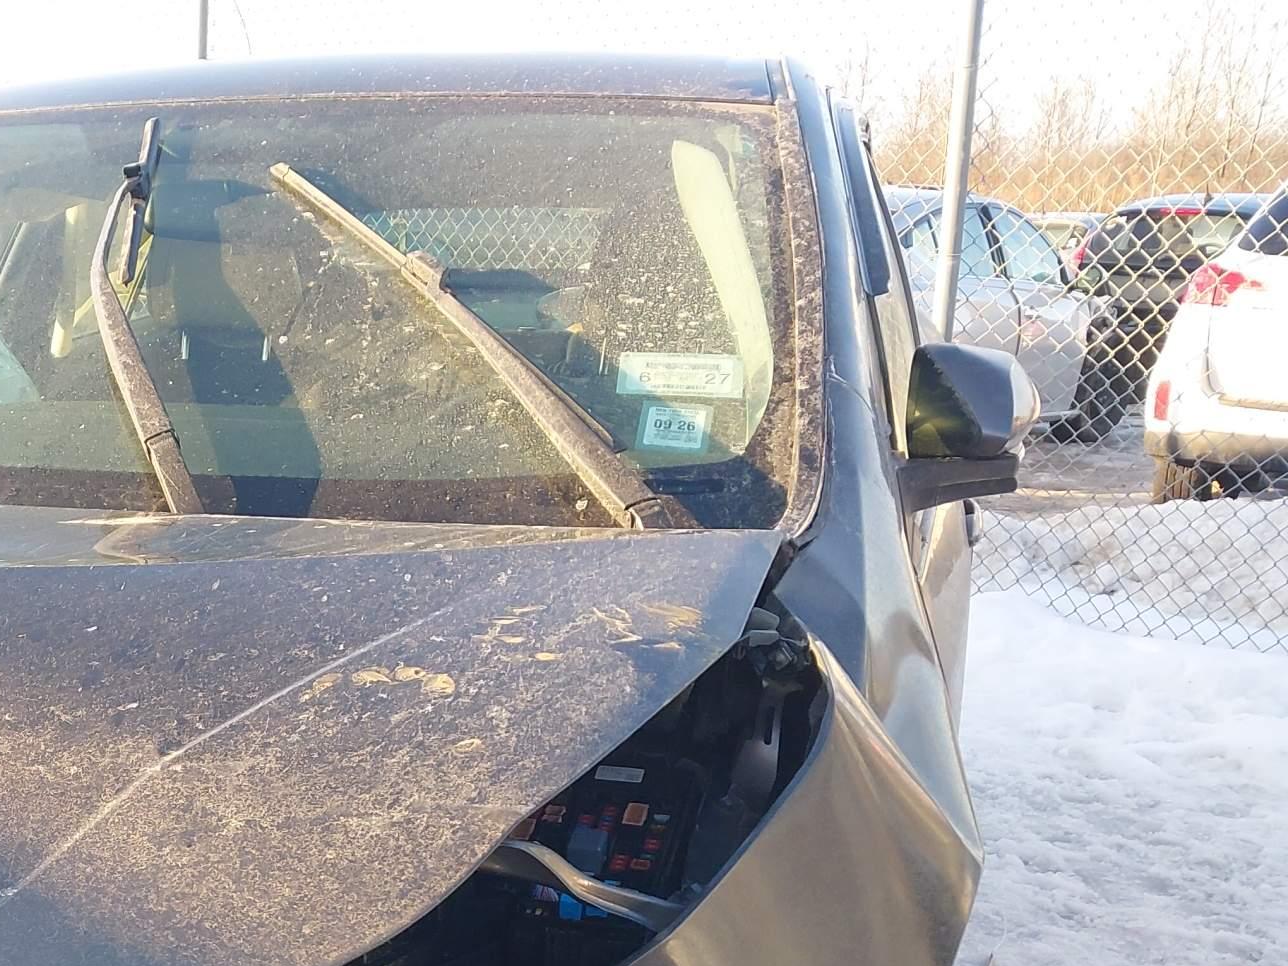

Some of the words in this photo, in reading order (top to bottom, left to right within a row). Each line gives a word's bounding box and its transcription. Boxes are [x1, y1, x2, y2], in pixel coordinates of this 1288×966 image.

[639, 371, 652, 384] 6
[704, 373, 731, 385] 27
[654, 418, 673, 430] 09
[677, 419, 696, 431] 26
